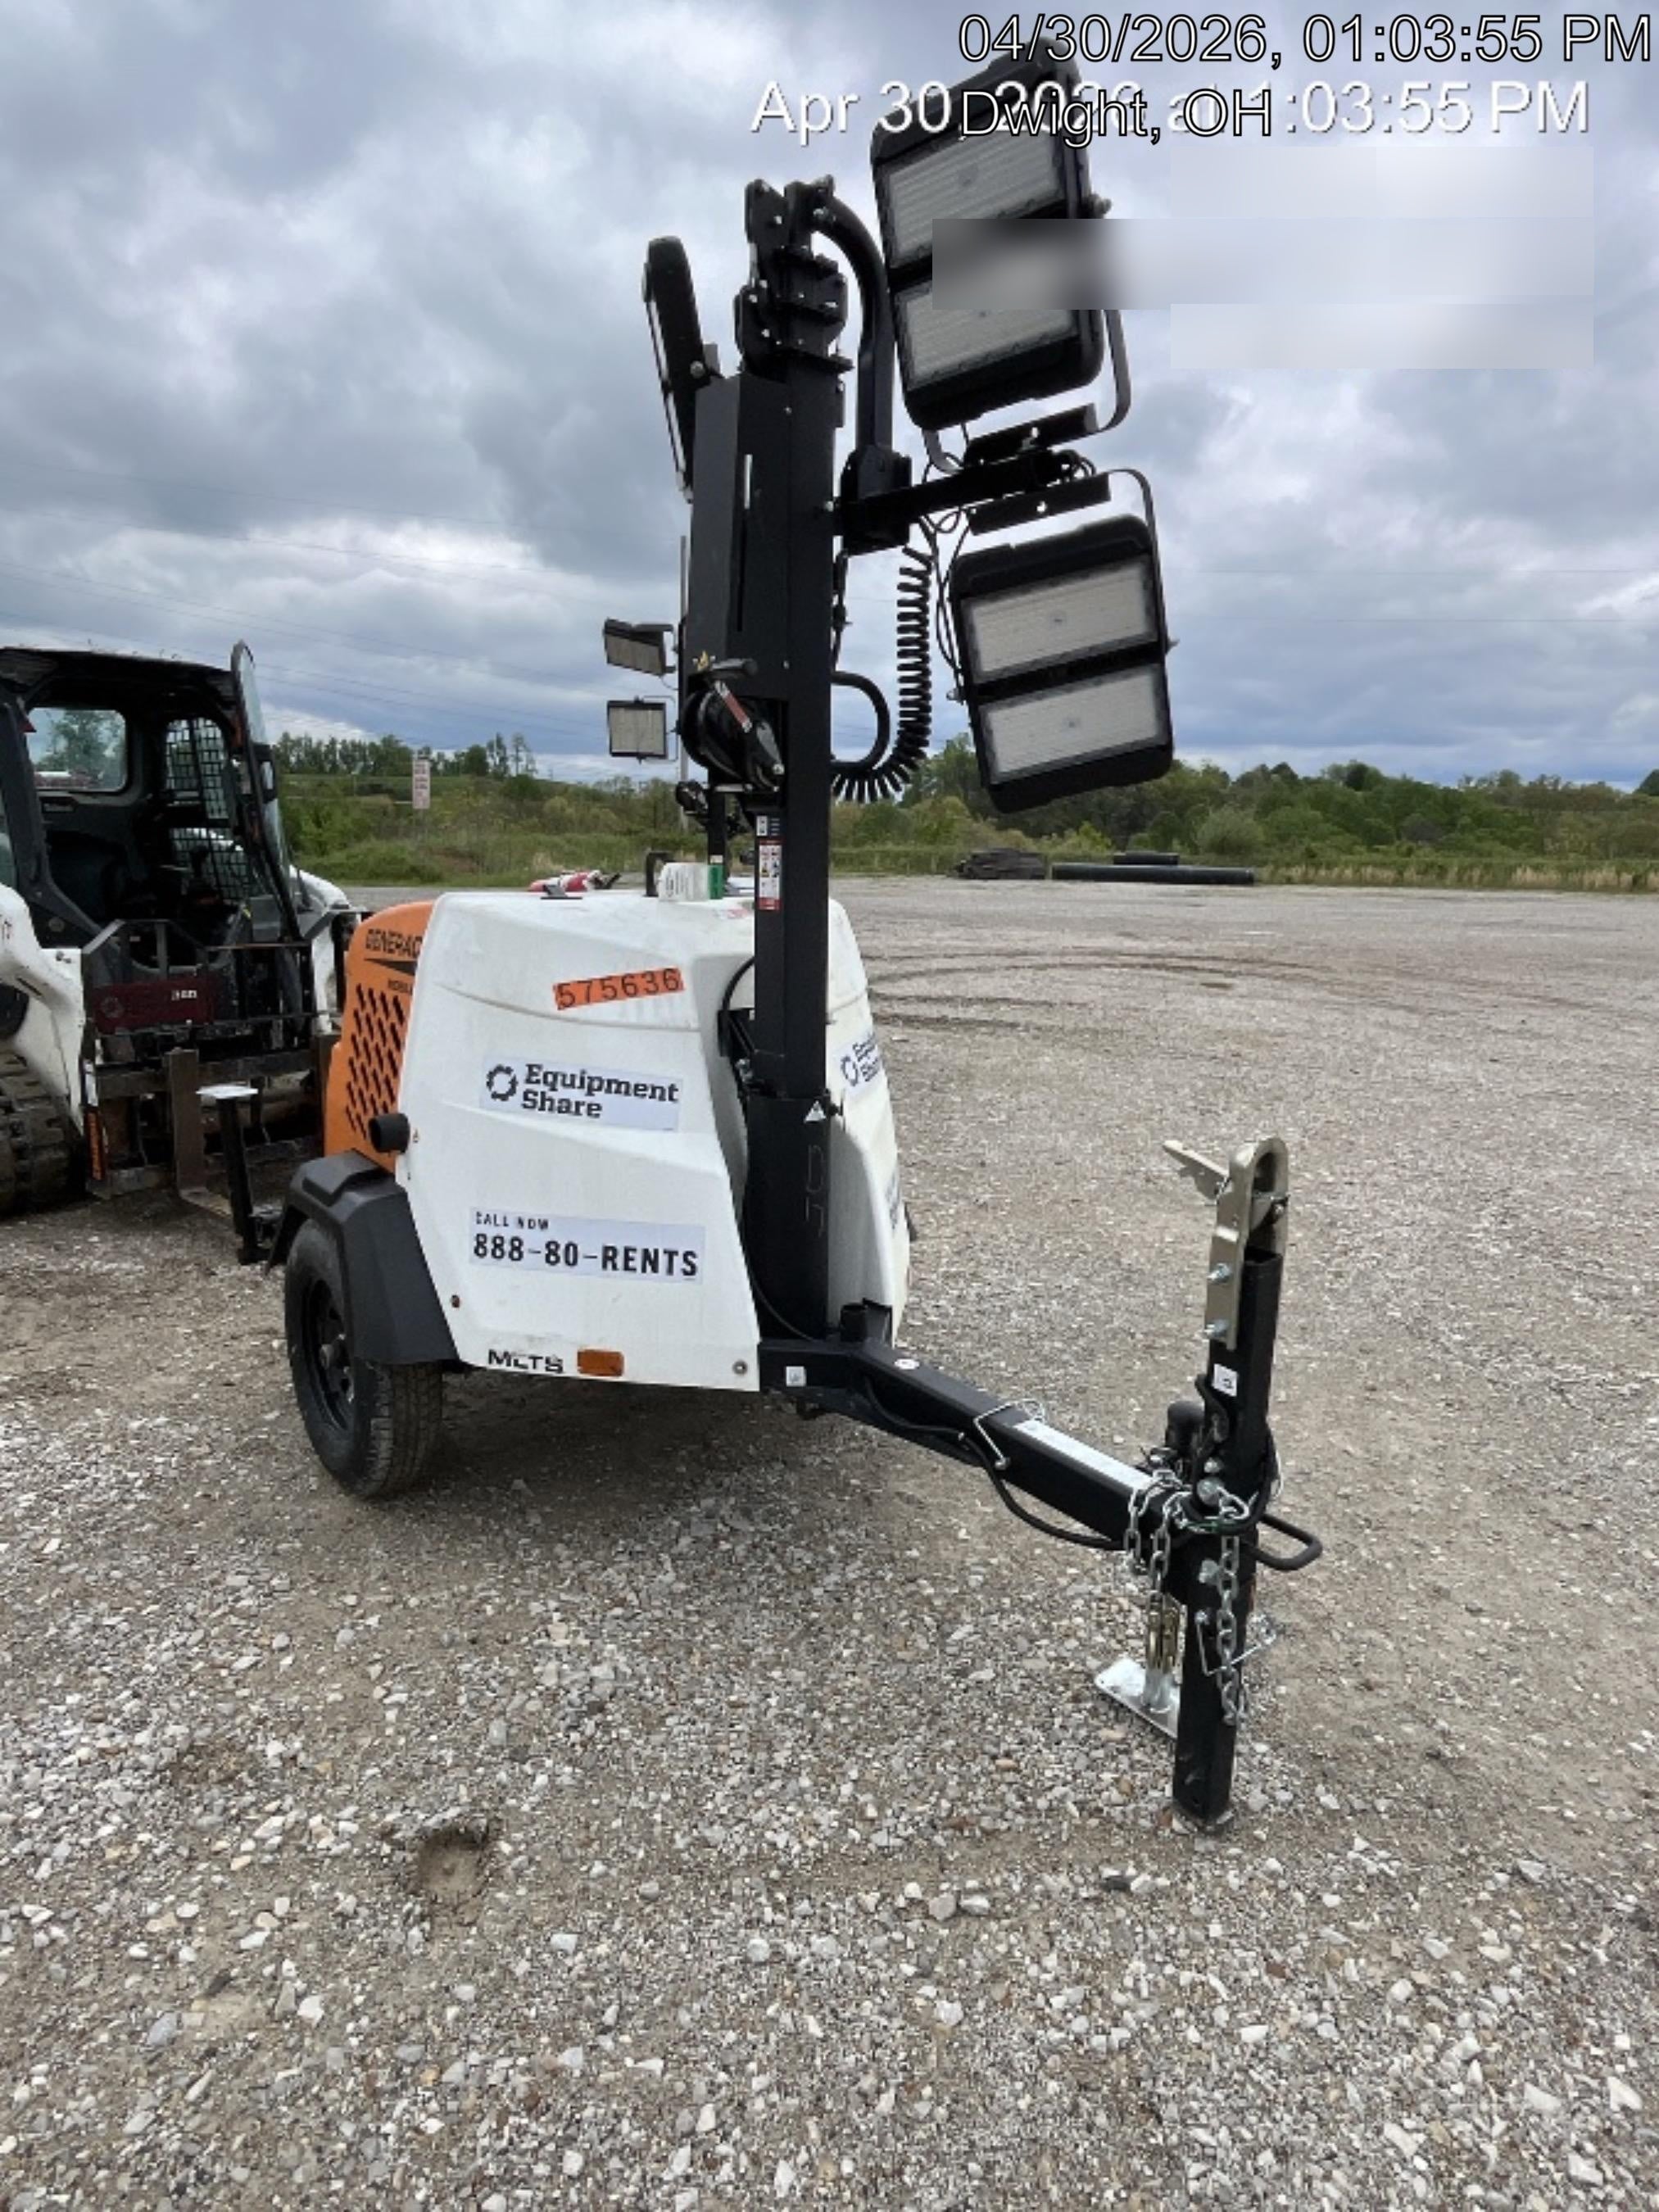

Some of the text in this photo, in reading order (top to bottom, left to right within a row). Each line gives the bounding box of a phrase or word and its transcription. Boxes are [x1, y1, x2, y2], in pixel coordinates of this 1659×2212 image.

[557, 968, 680, 1008] 575636
[524, 1063, 679, 1103] Equipment
[520, 1089, 602, 1118] Share
[475, 1211, 550, 1231] CALL NOW
[473, 1232, 699, 1277] 888-80-RENTS
